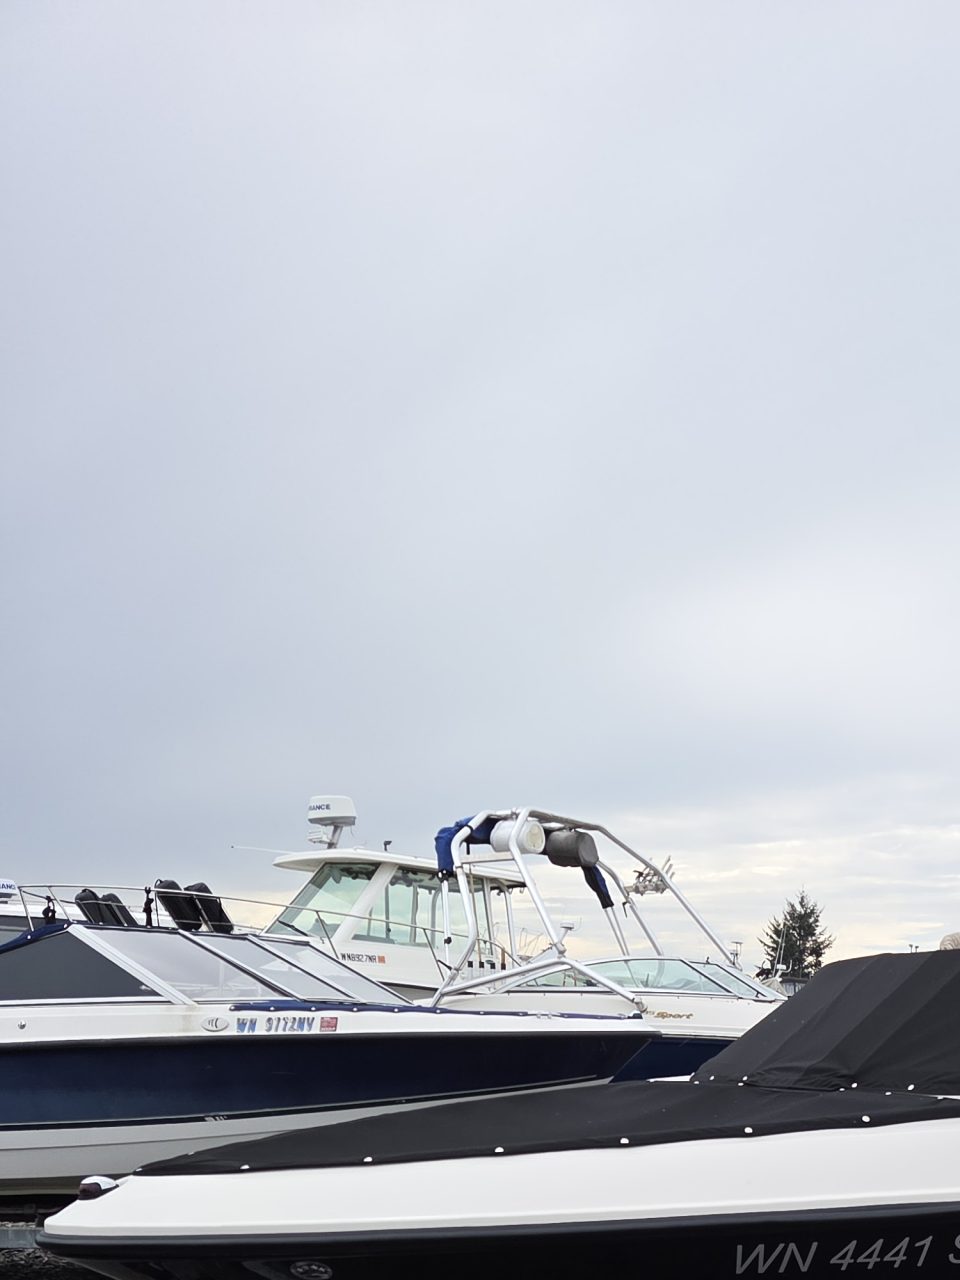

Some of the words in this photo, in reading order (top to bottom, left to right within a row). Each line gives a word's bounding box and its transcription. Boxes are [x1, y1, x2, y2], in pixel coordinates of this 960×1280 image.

[236, 1017, 257, 1033] WN
[735, 1241, 819, 1275] WN
[829, 1235, 934, 1272] 4441
